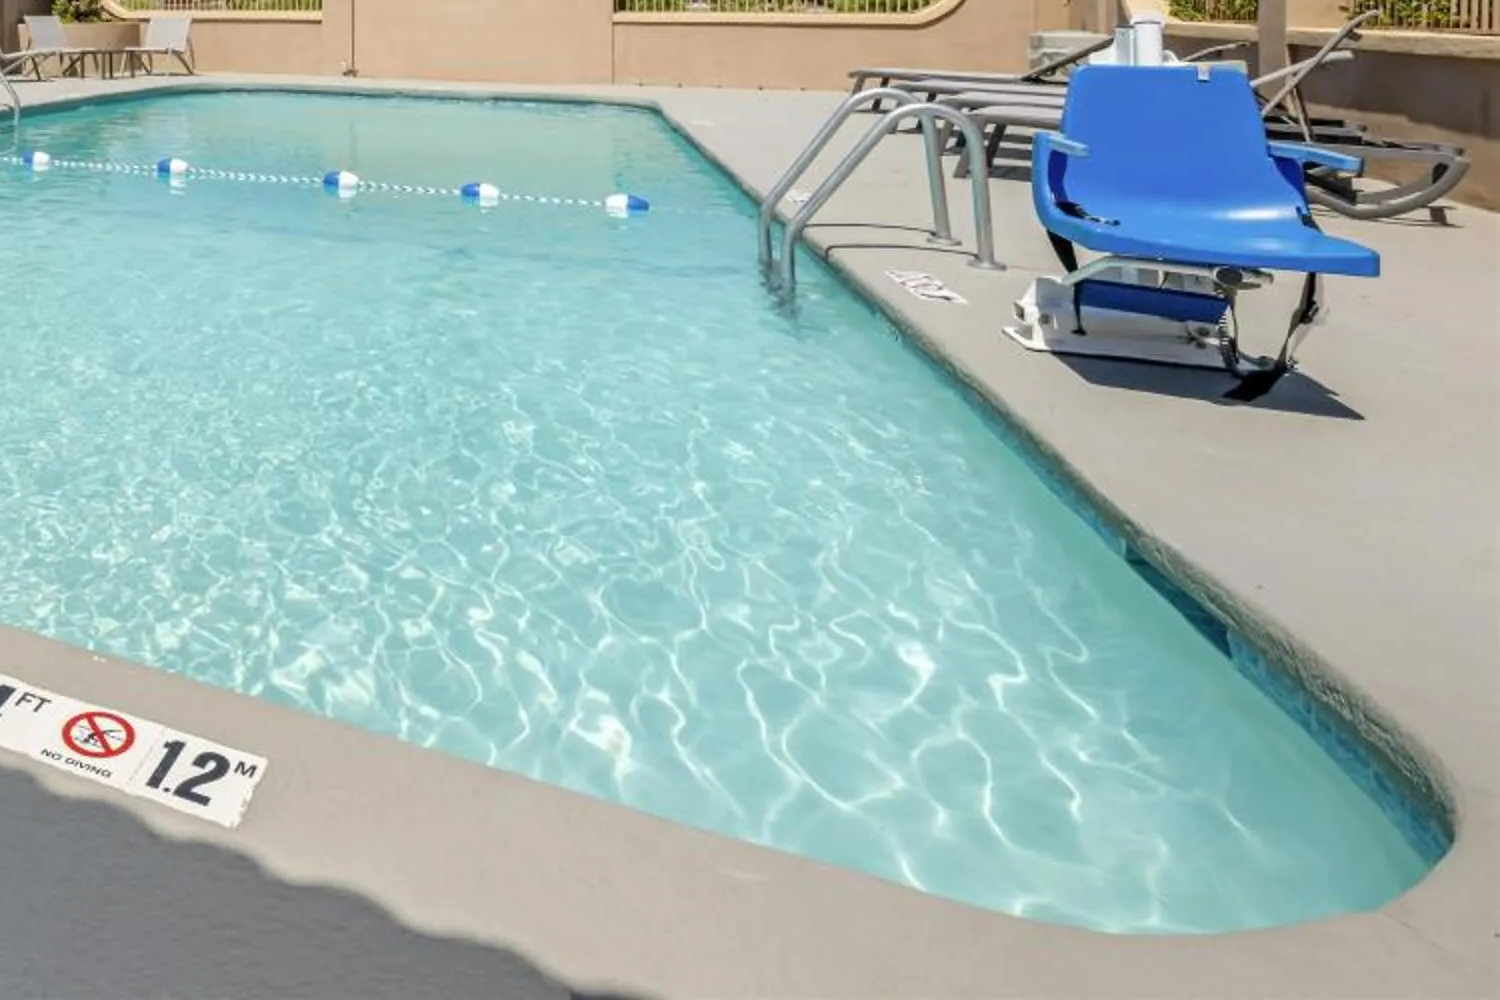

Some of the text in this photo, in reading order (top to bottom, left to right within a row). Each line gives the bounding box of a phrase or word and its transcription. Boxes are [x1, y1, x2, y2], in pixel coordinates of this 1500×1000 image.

[15, 692, 52, 713] FT
[40, 748, 113, 779] NO DIVING
[146, 740, 257, 806] 1.2 M
